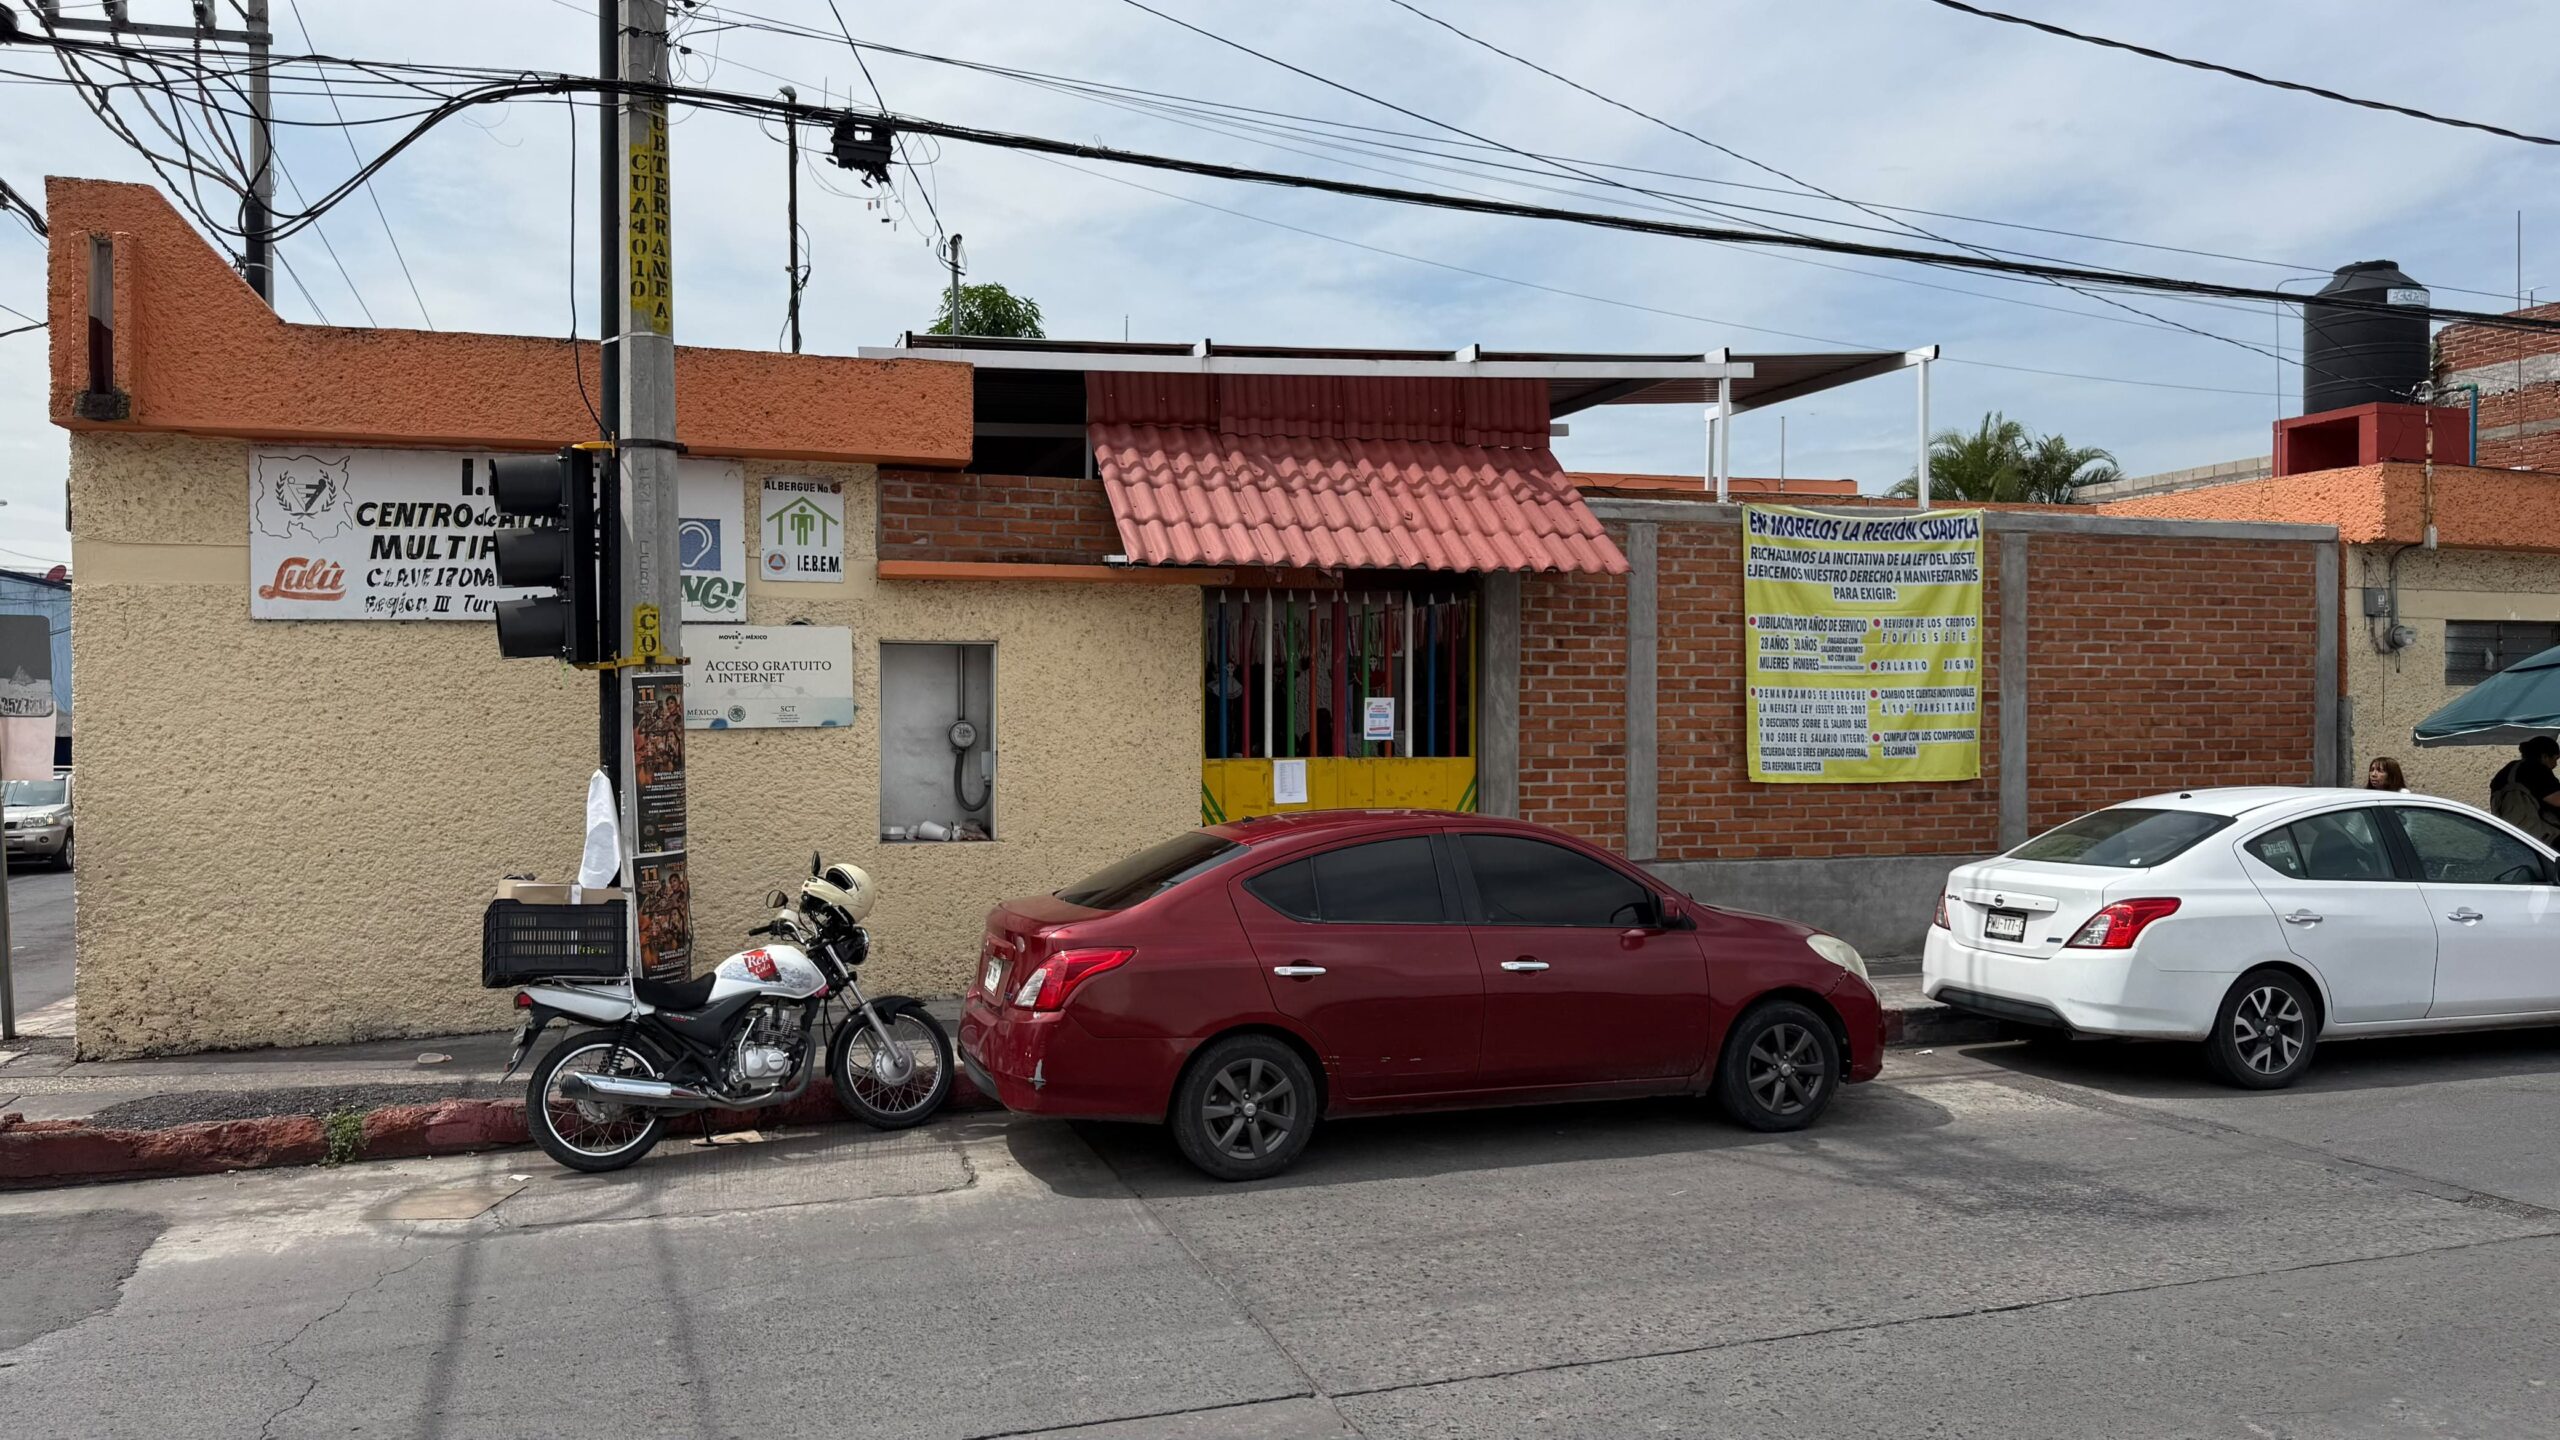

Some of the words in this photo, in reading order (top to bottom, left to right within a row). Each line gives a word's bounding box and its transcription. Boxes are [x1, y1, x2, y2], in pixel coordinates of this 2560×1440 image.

[764, 481, 815, 493] ALBERGUE
[356, 502, 474, 529] CENTRO
[474, 506, 498, 528] de
[1750, 511, 1767, 534] EN
[1771, 514, 1842, 541] MORELOS
[1842, 520, 1861, 541] LA
[1919, 518, 1979, 541] CUAUTLA
[797, 554, 842, 573] I.E.B.E.M.
[1818, 551, 1831, 565] LA
[1832, 551, 1885, 566] INCITATIVA
[1887, 552, 1899, 566] DE
[1901, 552, 1911, 566] LA
[1912, 552, 1929, 566] LEY
[1930, 552, 1948, 566] DEL
[366, 568, 435, 588] CLAVE
[1747, 563, 1803, 580] EJERCEMOS
[1804, 568, 1848, 582] NUESTRO
[1849, 570, 1894, 583] DERECHO
[1894, 570, 1902, 583] A
[1904, 568, 1979, 583] MANIFESTARNOS
[1833, 586, 1860, 600] PARA
[1860, 587, 1897, 601] EXIGIR:
[433, 595, 452, 613] III
[1794, 618, 1808, 631] POR
[1808, 616, 1828, 632] AÑOS
[1828, 619, 1838, 632] DE
[1838, 619, 1867, 633] SERVICIO
[1927, 618, 1942, 628] LOS
[1760, 637, 1769, 649] 28
[1769, 634, 1789, 650] AÑOS
[1801, 635, 1818, 651] AÑOS
[705, 660, 759, 672] ACCESO
[762, 660, 833, 672] GRATUITO
[1759, 656, 1790, 669] MUJERES
[1792, 657, 1820, 671] HOMBRES
[1880, 661, 1927, 671] SALARIO
[705, 673, 715, 683] A
[718, 672, 785, 683] INTERNET
[1759, 688, 1817, 699] DEMANDAMOS
[1819, 689, 1828, 699] SE
[1831, 690, 1866, 701] DEROGUE
[1880, 689, 1905, 699] CAMBIO
[1906, 689, 1915, 699] DE
[687, 708, 719, 716] MÉXICO
[780, 705, 797, 713] SCT
[1759, 703, 1767, 713] LA
[1769, 703, 1797, 713] NEFASTA
[1800, 704, 1812, 714] LEY
[1836, 705, 1848, 714] DEL
[1881, 704, 1887, 714] A
[1765, 718, 1799, 728] DESCUENTOS
[1802, 718, 1821, 728] SOBRE
[1823, 719, 1830, 729] EL
[1830, 719, 1852, 729] SALARIO
[1853, 719, 1867, 729] BASE
[1765, 732, 1775, 742] NO
[1777, 732, 1797, 742] SOBRE
[1800, 733, 1808, 742] EL
[1810, 733, 1837, 743] SALARIO
[1908, 732, 1920, 741] CON
[1921, 731, 1932, 741] LOS
[1933, 730, 1975, 741] COMPROMISOS
[1785, 747, 1796, 757] QUE
[1803, 747, 1816, 757] ERES
[1817, 747, 1845, 757] EMPLEADO
[1883, 746, 1891, 756] DE
[1891, 744, 1917, 756] CAMPAÑA
[1772, 761, 1796, 771] REFORMA
[1796, 762, 1802, 771] TE
[1803, 761, 1821, 771] AFECTA
[744, 953, 770, 968] Red
[756, 963, 771, 973] Cola
